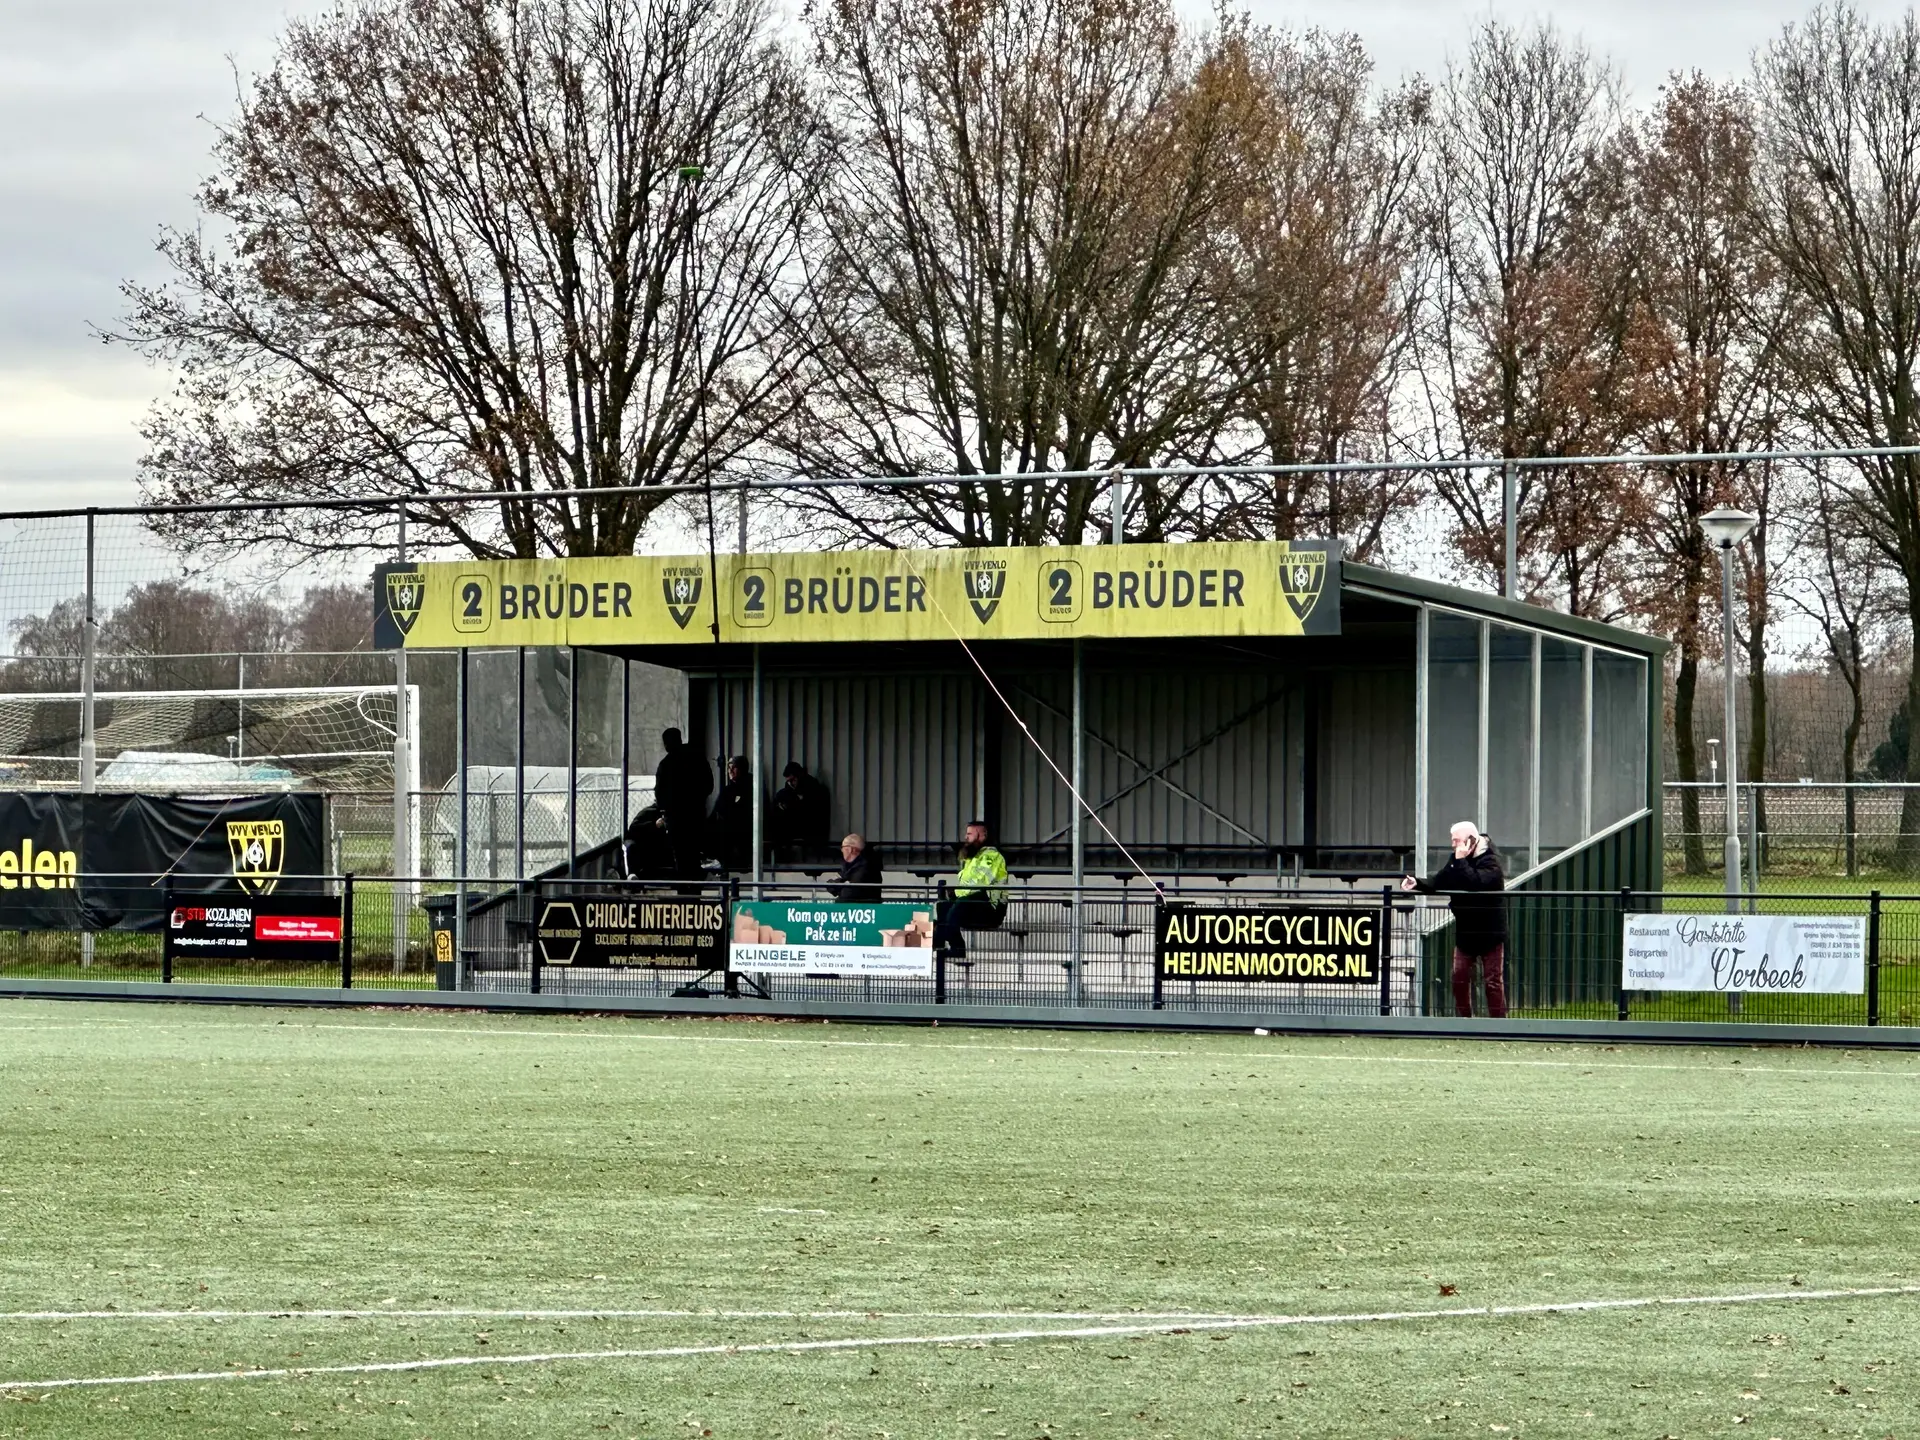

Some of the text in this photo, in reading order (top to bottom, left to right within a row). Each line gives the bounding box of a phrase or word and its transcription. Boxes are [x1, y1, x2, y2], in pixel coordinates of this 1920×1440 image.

[743, 567, 927, 615] 2 BRÜDER
[1049, 560, 1245, 609] 2 BRÜDER
[462, 574, 632, 620] 2 BRÜDER
[640, 903, 723, 930] INTERIEURS
[787, 907, 812, 922] Kom
[813, 911, 828, 926] op
[847, 908, 876, 924] VOS!
[594, 933, 628, 946] EXCLUSIVE
[805, 926, 857, 942] Pak ze in!
[1165, 914, 1373, 946] AUTORECYCLING
[1628, 927, 1670, 937] Restaurant
[735, 949, 807, 962] KLINGELE
[1164, 951, 1373, 978] HEIJNENMOTORS.NL
[1628, 948, 1668, 960] Biergarten
[1628, 968, 1665, 979] Truckstop
[1710, 947, 1807, 991] Verbeek
